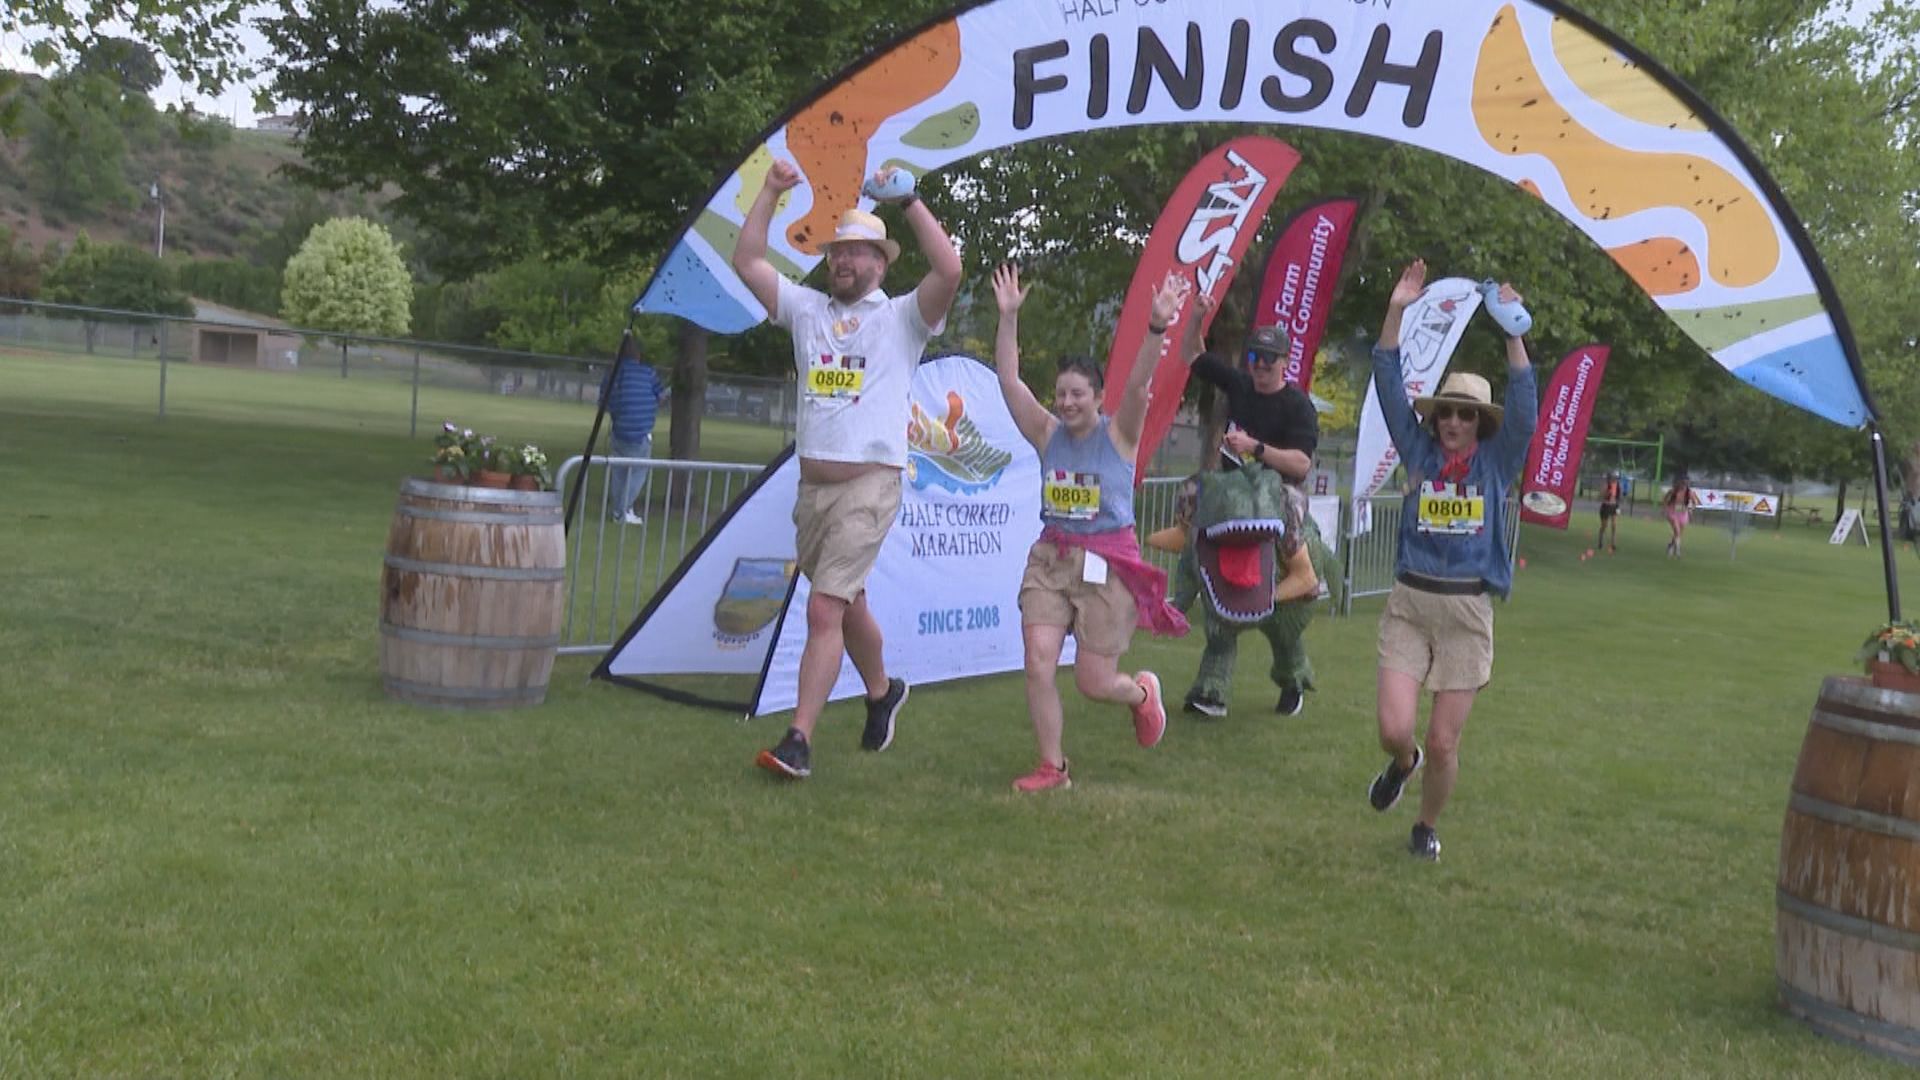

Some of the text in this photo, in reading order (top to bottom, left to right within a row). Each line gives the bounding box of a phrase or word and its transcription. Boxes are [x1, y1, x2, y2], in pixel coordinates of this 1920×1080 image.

[1012, 17, 1444, 129] FINISH
[1291, 214, 1336, 335] Community
[1275, 263, 1302, 318] Farm
[816, 370, 855, 387] 0802
[1535, 384, 1570, 485] From the Farm
[1550, 352, 1596, 487] to Your Community
[1052, 486, 1091, 505] 0803
[1428, 499, 1473, 516] 0801
[901, 503, 1009, 527] HALF CORKED
[911, 531, 1002, 557] MARATHON
[917, 605, 1000, 636] SINCE 2008
